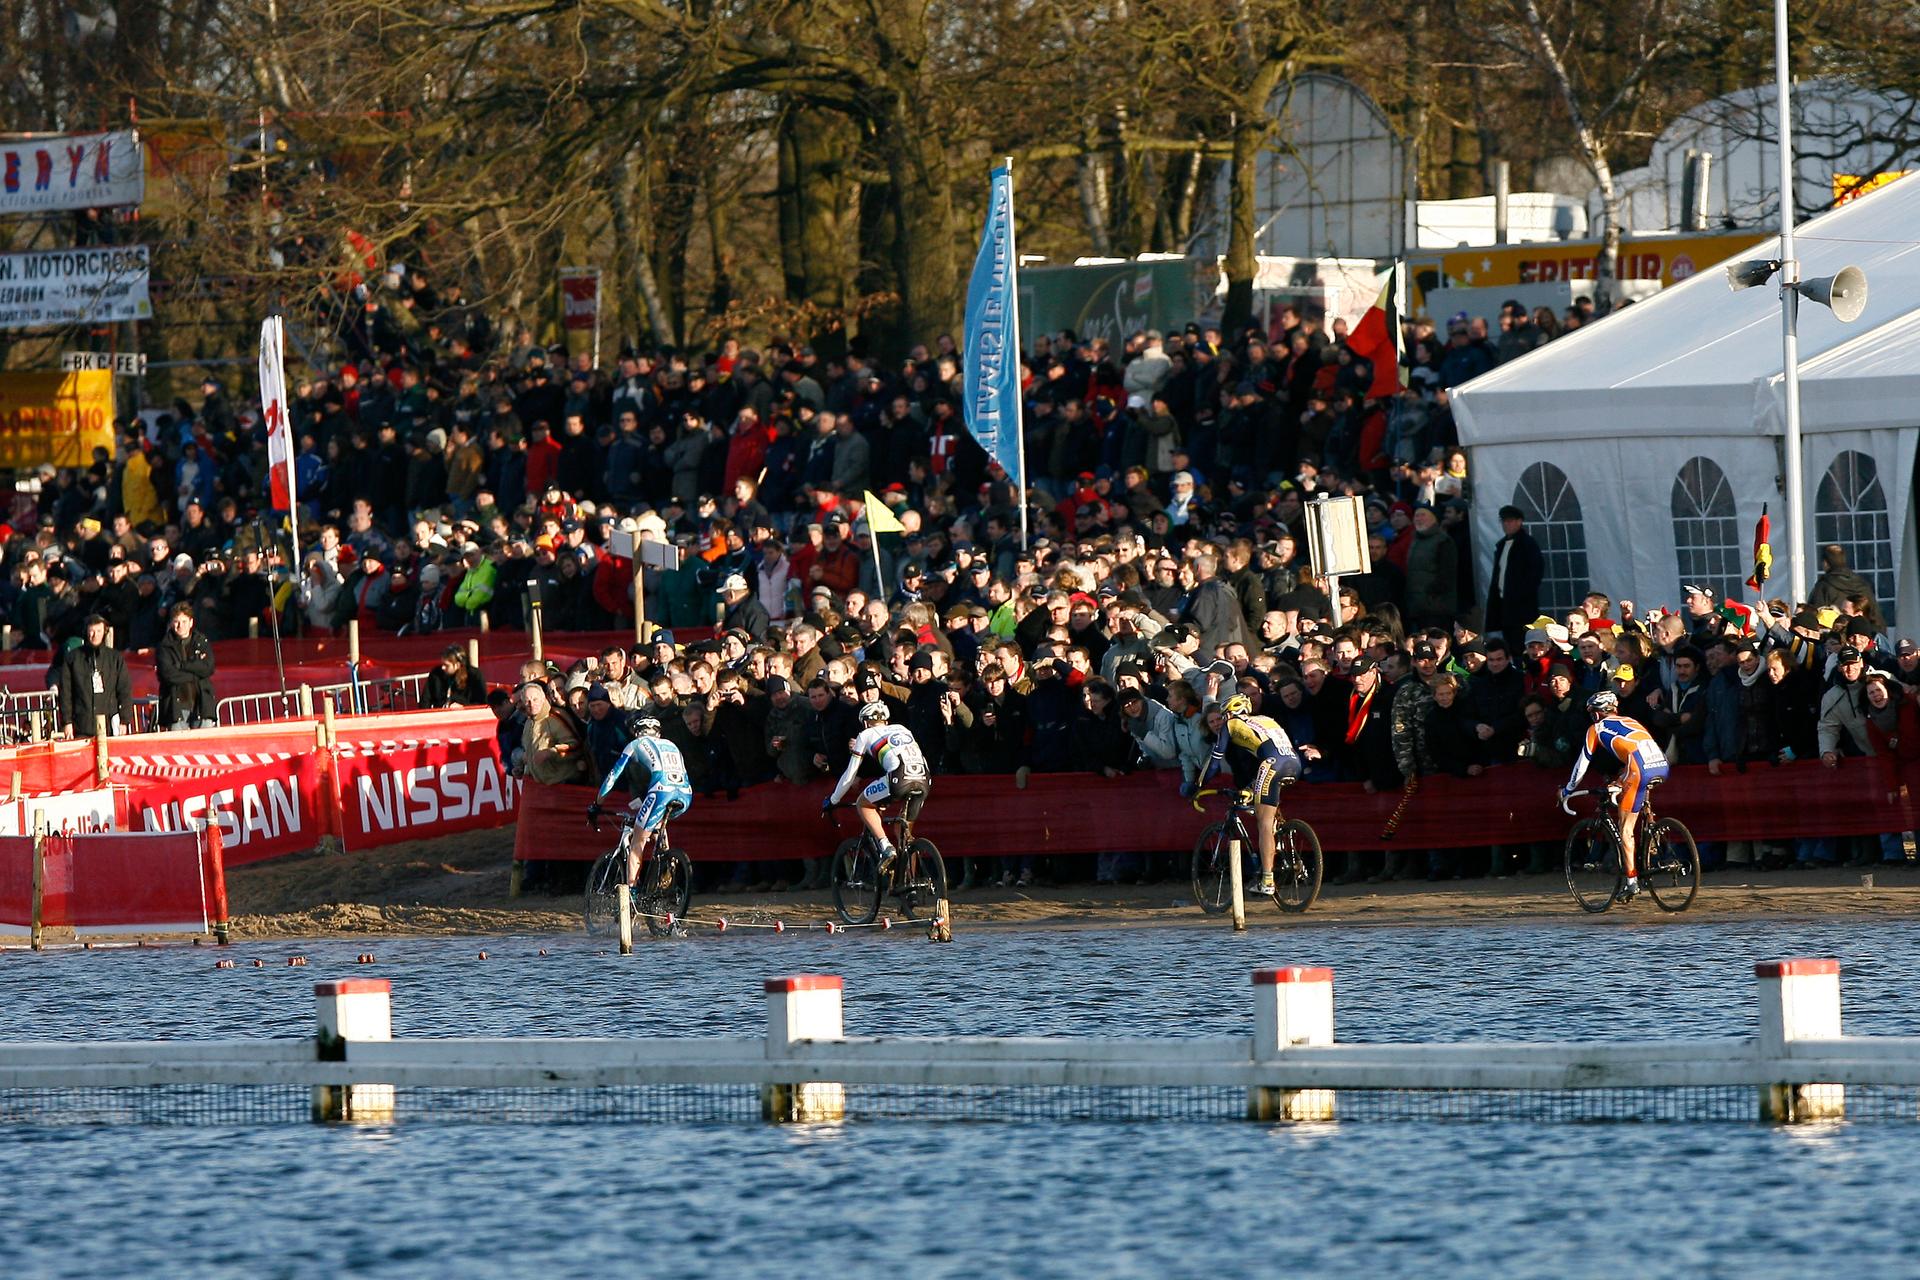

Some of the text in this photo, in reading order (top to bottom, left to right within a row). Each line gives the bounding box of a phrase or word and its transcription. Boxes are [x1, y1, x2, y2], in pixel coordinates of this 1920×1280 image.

[24, 249, 146, 279] MOTORCROSS
[1519, 254, 1662, 283] FRITUR
[664, 753, 678, 765] 10
[865, 782, 887, 797] FIDEA
